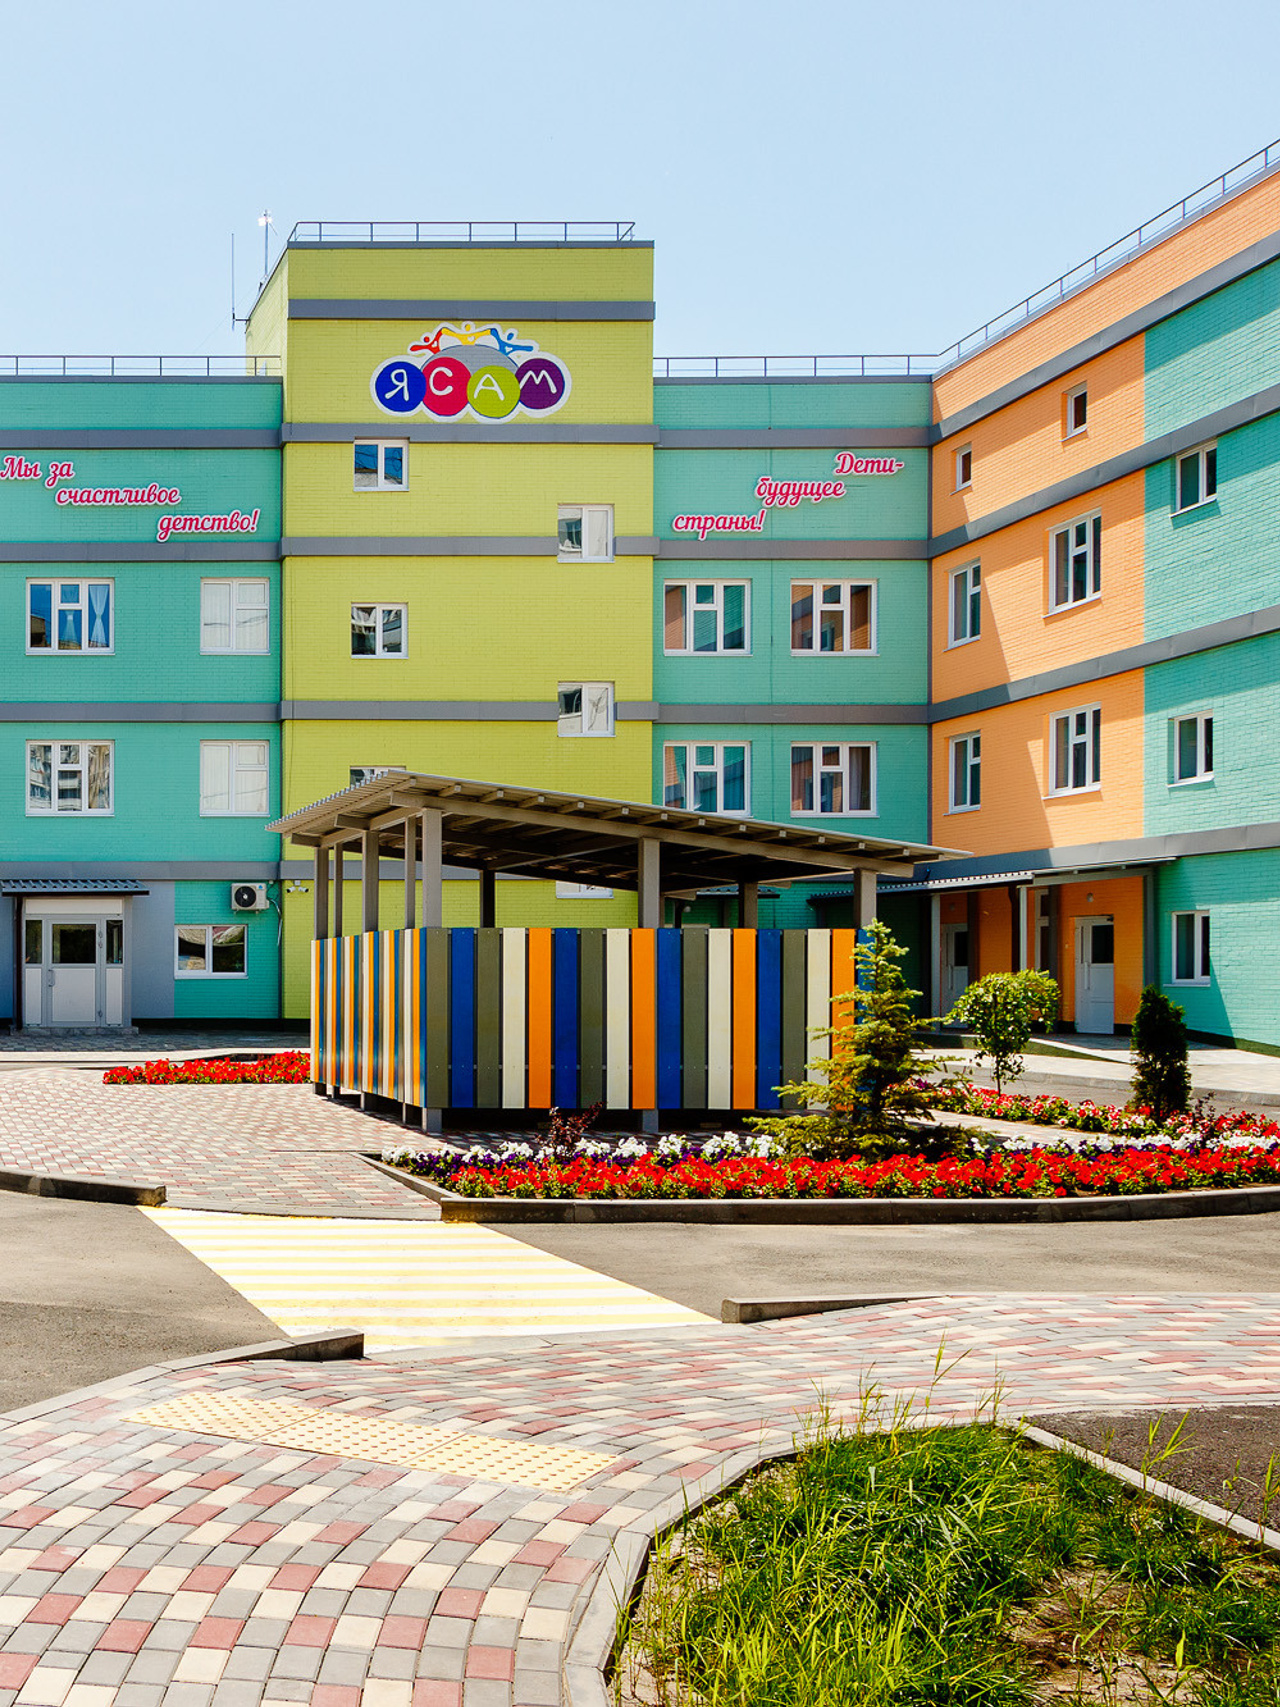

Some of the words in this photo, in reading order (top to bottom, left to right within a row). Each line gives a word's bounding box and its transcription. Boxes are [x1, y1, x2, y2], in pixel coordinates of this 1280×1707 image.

[0, 456, 41, 479] Мы
[45, 461, 74, 487] за
[834, 452, 904, 474] Дети-
[56, 483, 181, 505] счастливое
[755, 476, 846, 507] будущее
[157, 508, 260, 541] детство!
[673, 509, 766, 539] страны!
